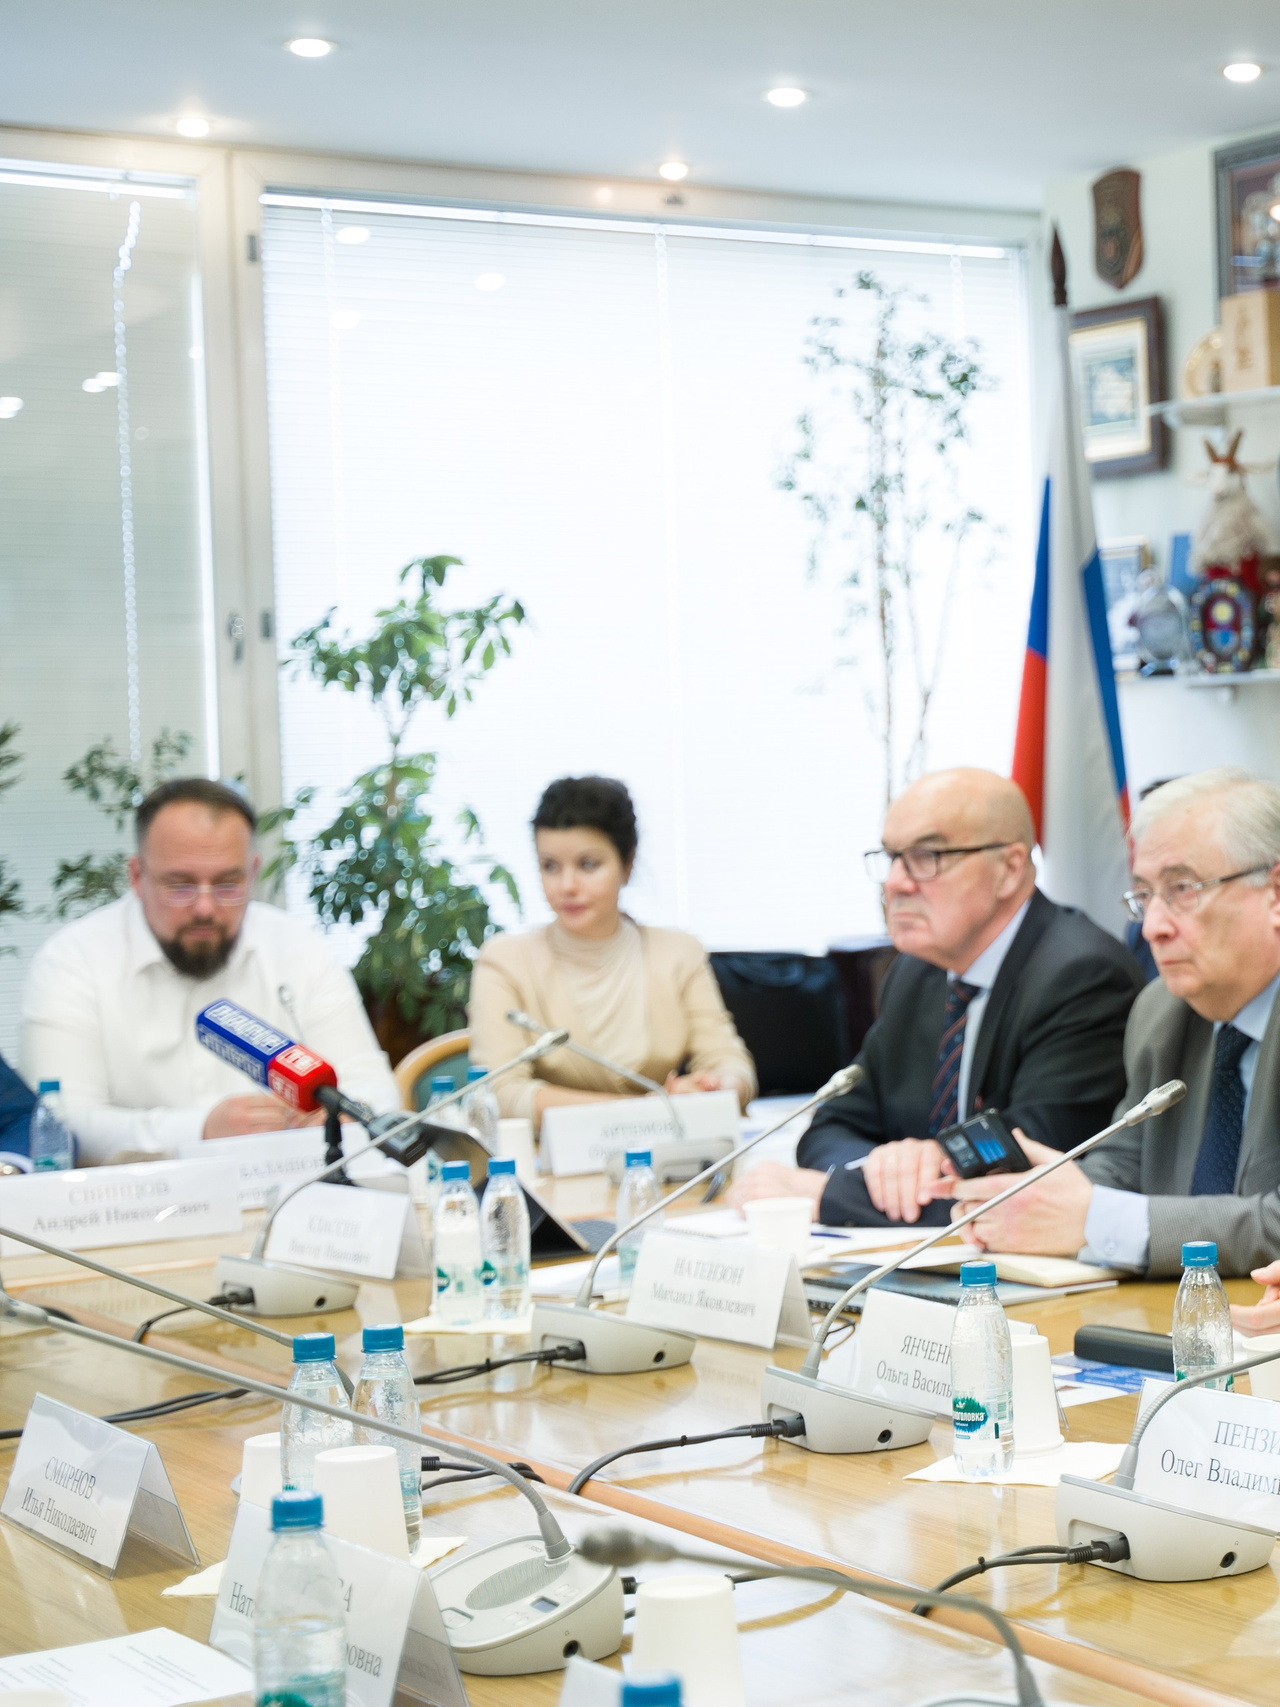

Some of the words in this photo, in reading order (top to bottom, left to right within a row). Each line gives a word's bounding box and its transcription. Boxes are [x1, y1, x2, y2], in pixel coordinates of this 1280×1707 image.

[695, 1288, 756, 1318] Яковлевич
[876, 1360, 909, 1387] Ольга
[912, 1369, 953, 1398] Василь
[44, 1456, 97, 1500] СМИРНОВ
[1161, 1449, 1203, 1479] Олег
[21, 1486, 45, 1519] Илья
[43, 1497, 98, 1546] Николаевич
[229, 1581, 255, 1618] Нат
[345, 1643, 382, 1678] овна
